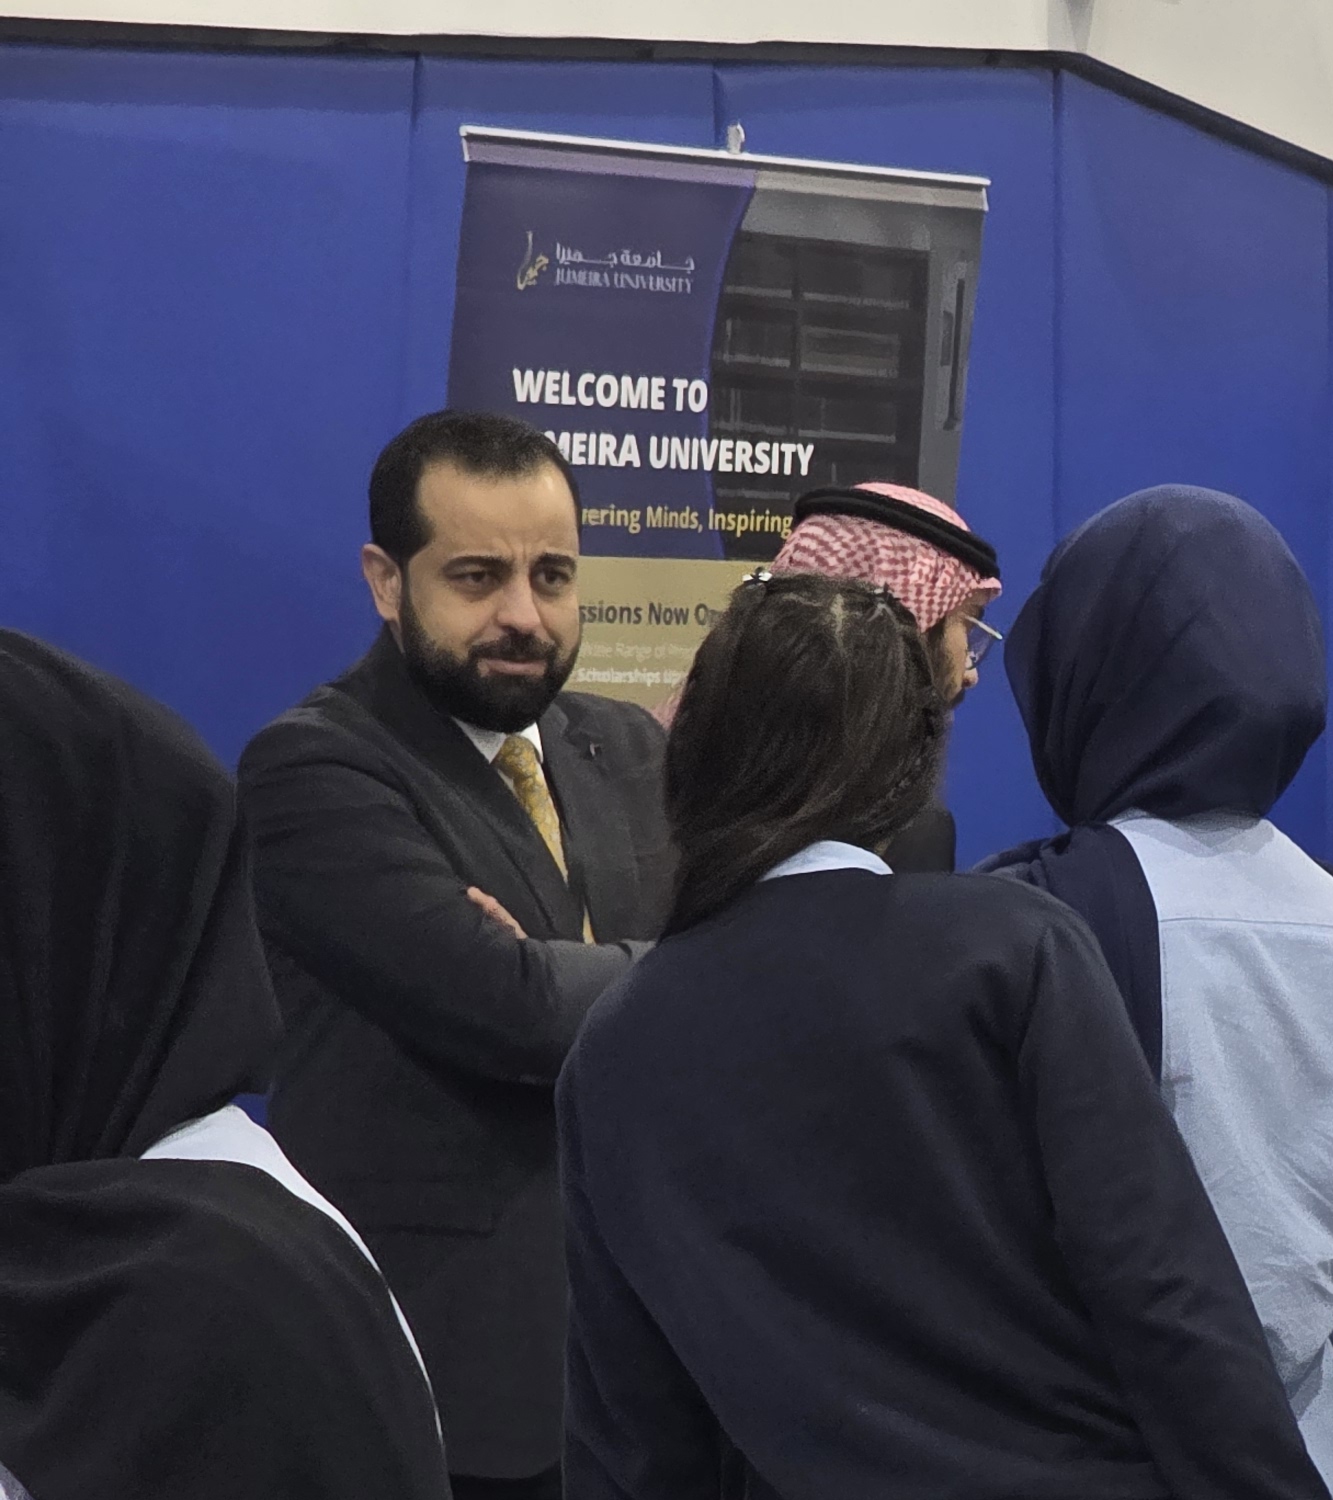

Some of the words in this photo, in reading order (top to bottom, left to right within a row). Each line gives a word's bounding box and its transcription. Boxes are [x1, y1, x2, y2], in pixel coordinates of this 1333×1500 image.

[614, 271, 695, 294] UNIVERSITY
[512, 368, 666, 411] WELCOME
[672, 377, 708, 413] TO
[544, 430, 641, 468] MEIRA
[649, 435, 815, 476] UNIVERSITY
[582, 503, 641, 534] ering
[646, 505, 703, 533] Minds,
[708, 508, 794, 539] Inspiring
[579, 599, 643, 625] ssions
[648, 602, 690, 625] Now
